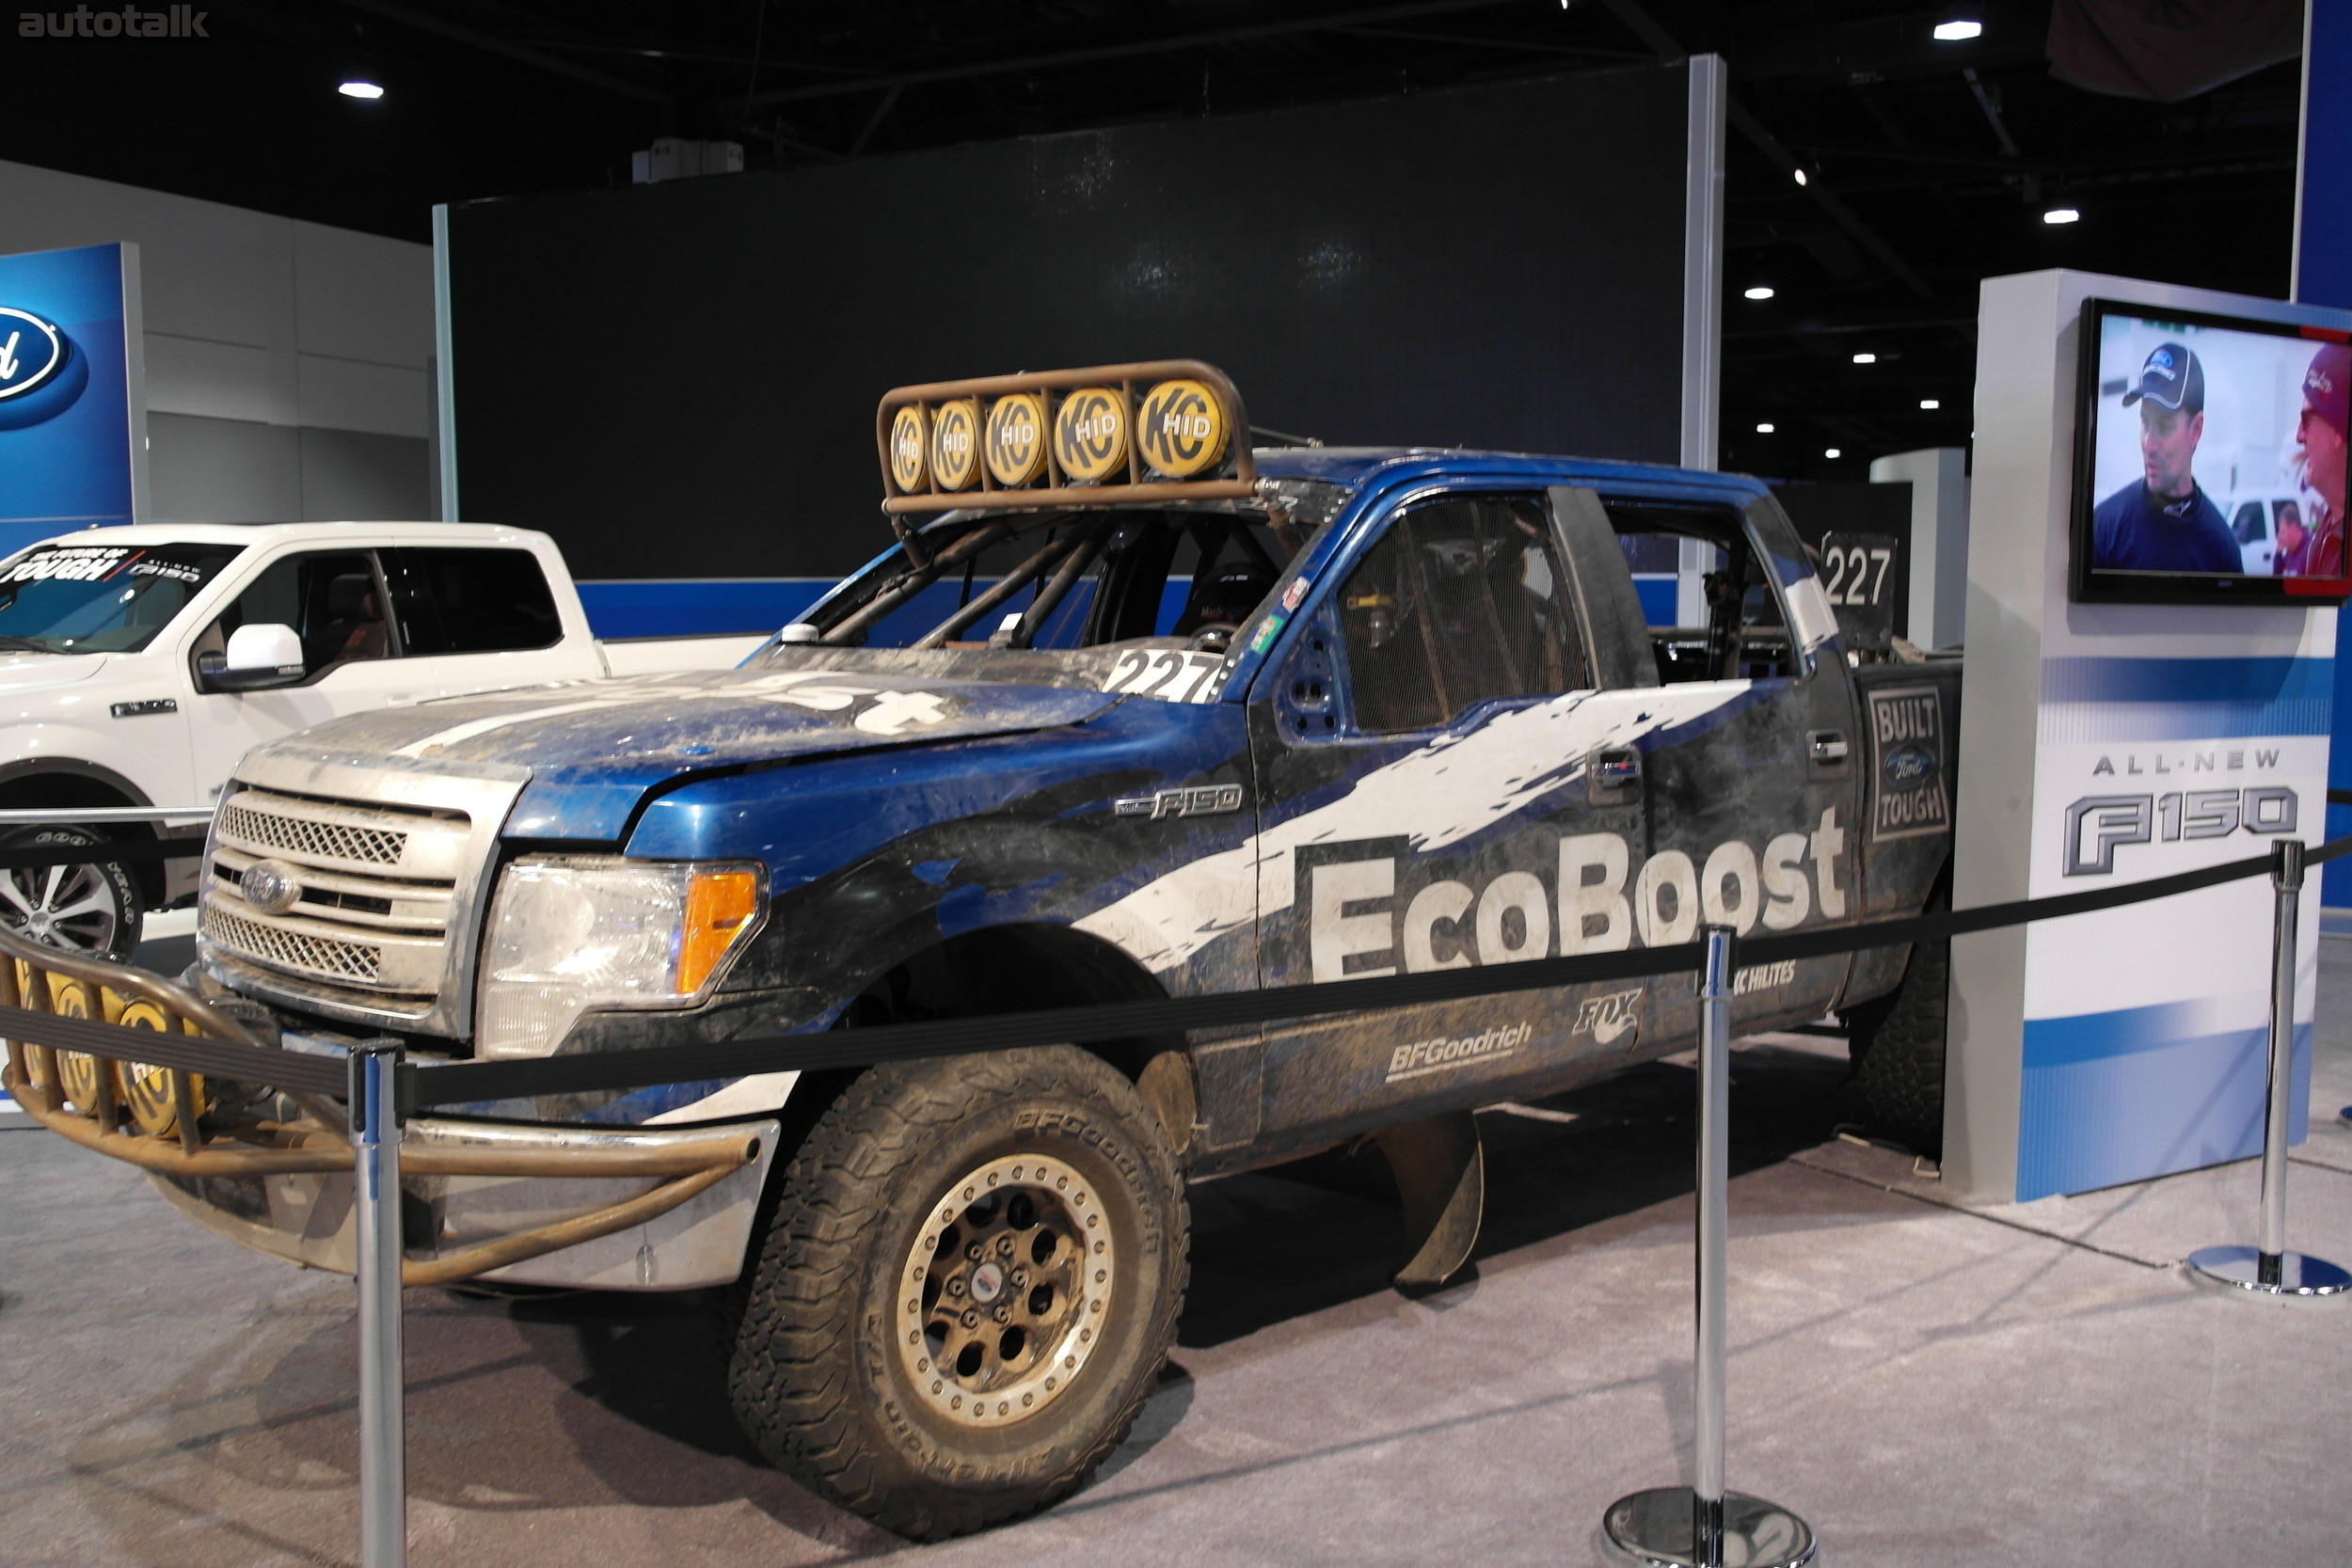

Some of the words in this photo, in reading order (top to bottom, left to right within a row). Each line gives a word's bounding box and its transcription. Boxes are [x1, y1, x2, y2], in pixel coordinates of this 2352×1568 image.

[943, 433, 969, 453] HID
[1001, 423, 1034, 447] HID
[1075, 412, 1118, 444] HID
[1162, 412, 1211, 439] HID
[898, 436, 920, 461] HID
[1825, 546, 1891, 605] 227
[1106, 652, 1224, 704] 227
[1877, 698, 1935, 743] BUILT
[1881, 786, 1943, 828] TOUGH
[1311, 805, 1845, 985] EcoBoost
[1572, 988, 1644, 1036] FOX
[1388, 1020, 1534, 1072] BFGoodrich
